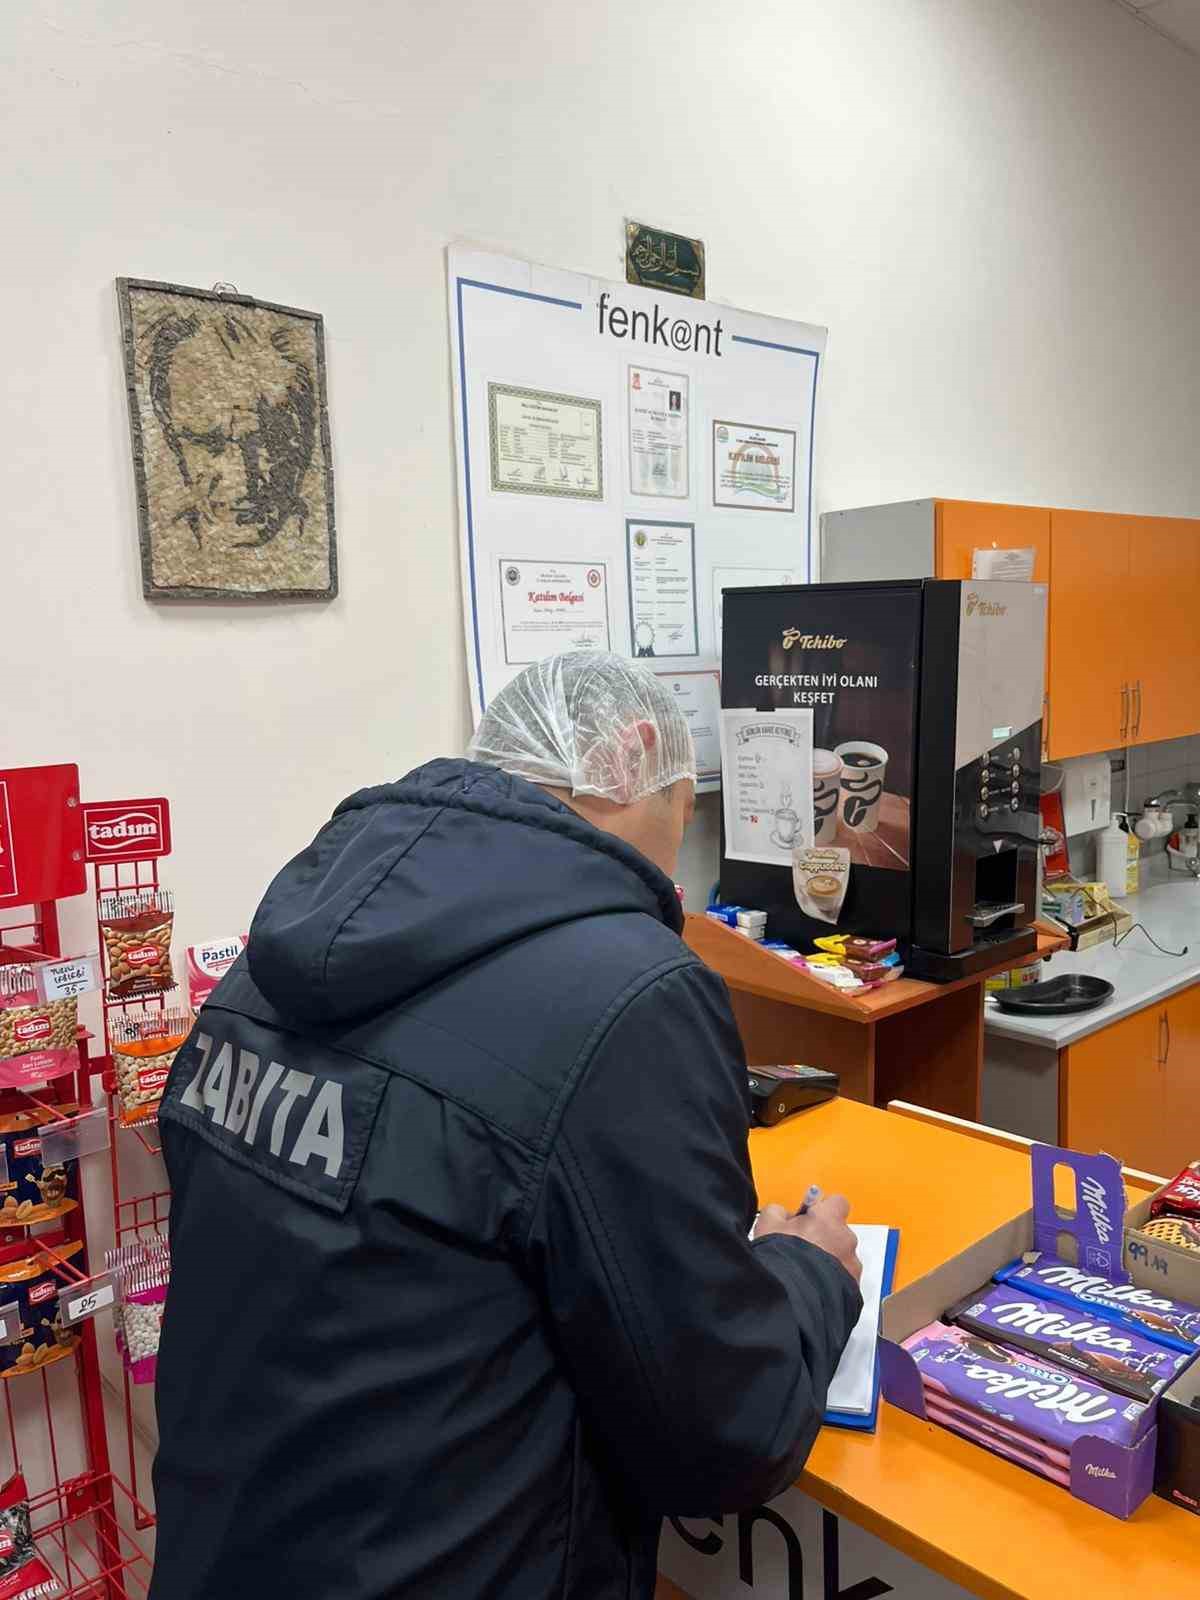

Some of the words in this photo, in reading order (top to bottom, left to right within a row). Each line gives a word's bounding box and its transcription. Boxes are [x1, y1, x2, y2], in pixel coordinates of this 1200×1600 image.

[597, 293, 723, 356] fenk@nt
[799, 635, 848, 650] Tchibo
[755, 674, 819, 689] GERÇEKTEN
[822, 672, 837, 687] İYİ
[839, 675, 878, 688] OLANI
[793, 691, 835, 706] KEŞFET
[88, 820, 158, 840] tadım
[128, 949, 158, 961] tadım
[202, 945, 238, 963] Pastil
[16, 1022, 50, 1034] tadım
[180, 1031, 345, 1179] ZABITA
[1081, 1176, 1114, 1245] Milka
[1038, 1266, 1178, 1312] Milka
[991, 1302, 1137, 1352] Milka
[962, 1363, 1117, 1423] Milka
[1085, 1463, 1117, 1479] Milka
